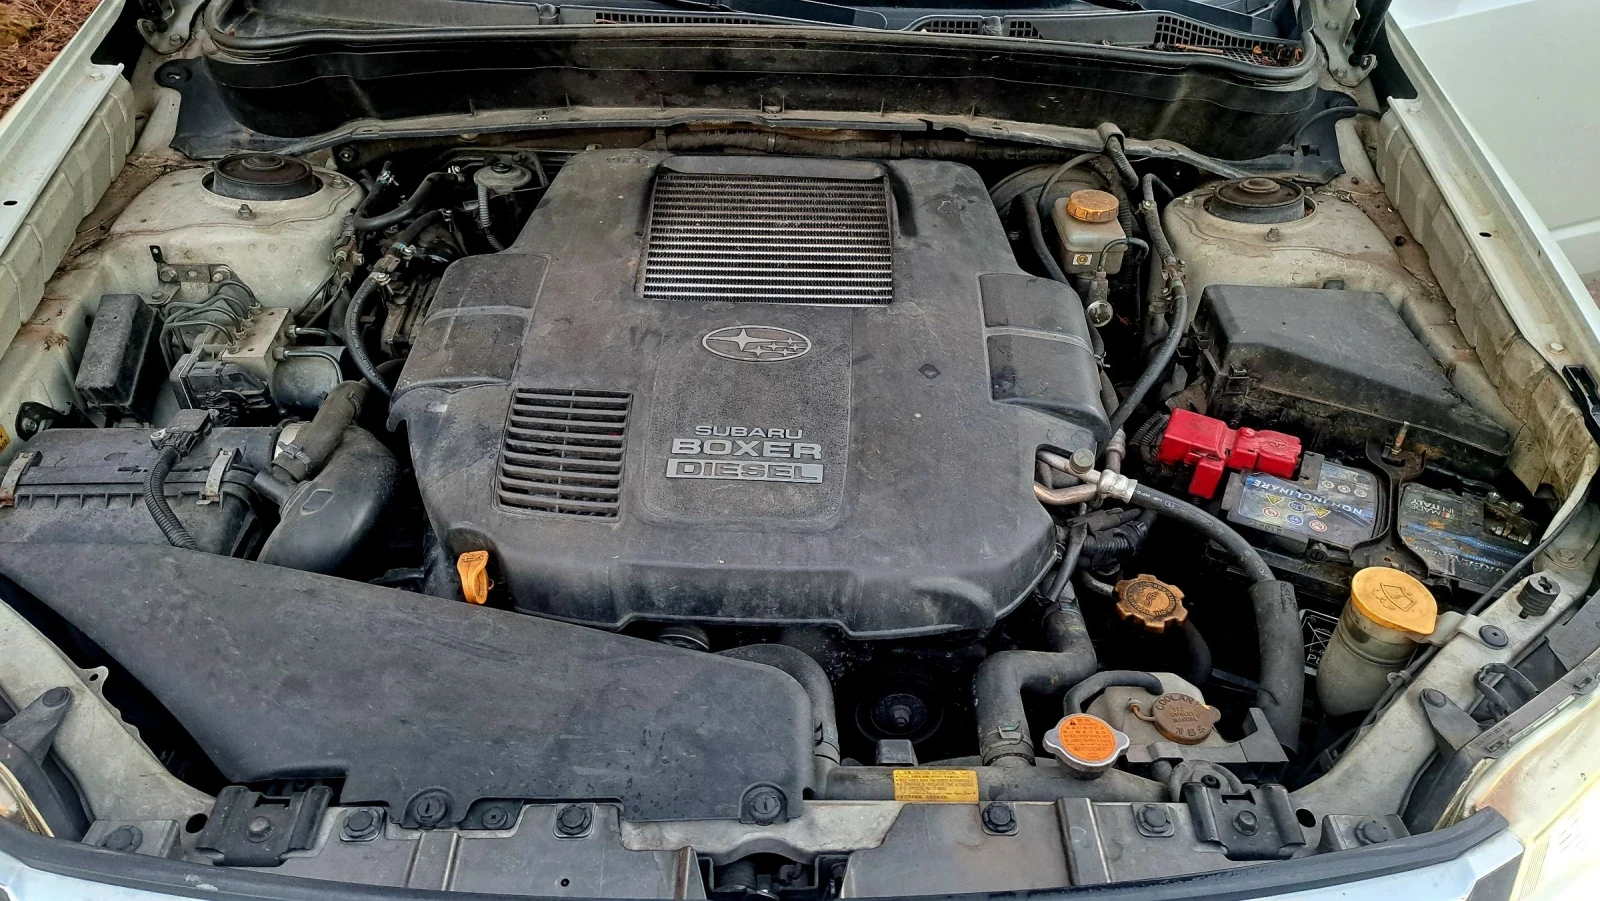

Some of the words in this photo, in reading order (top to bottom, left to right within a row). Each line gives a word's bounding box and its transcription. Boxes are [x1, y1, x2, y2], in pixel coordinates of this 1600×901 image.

[695, 425, 803, 439] SUBARU
[671, 438, 822, 459] BOXER
[670, 460, 821, 482] DIESEL
[1253, 479, 1328, 505] INCLINARE
[1332, 501, 1363, 516] NON
[1410, 498, 1440, 511] ITALY
[1411, 503, 1442, 516] MADE
[1443, 506, 1454, 514] IN
